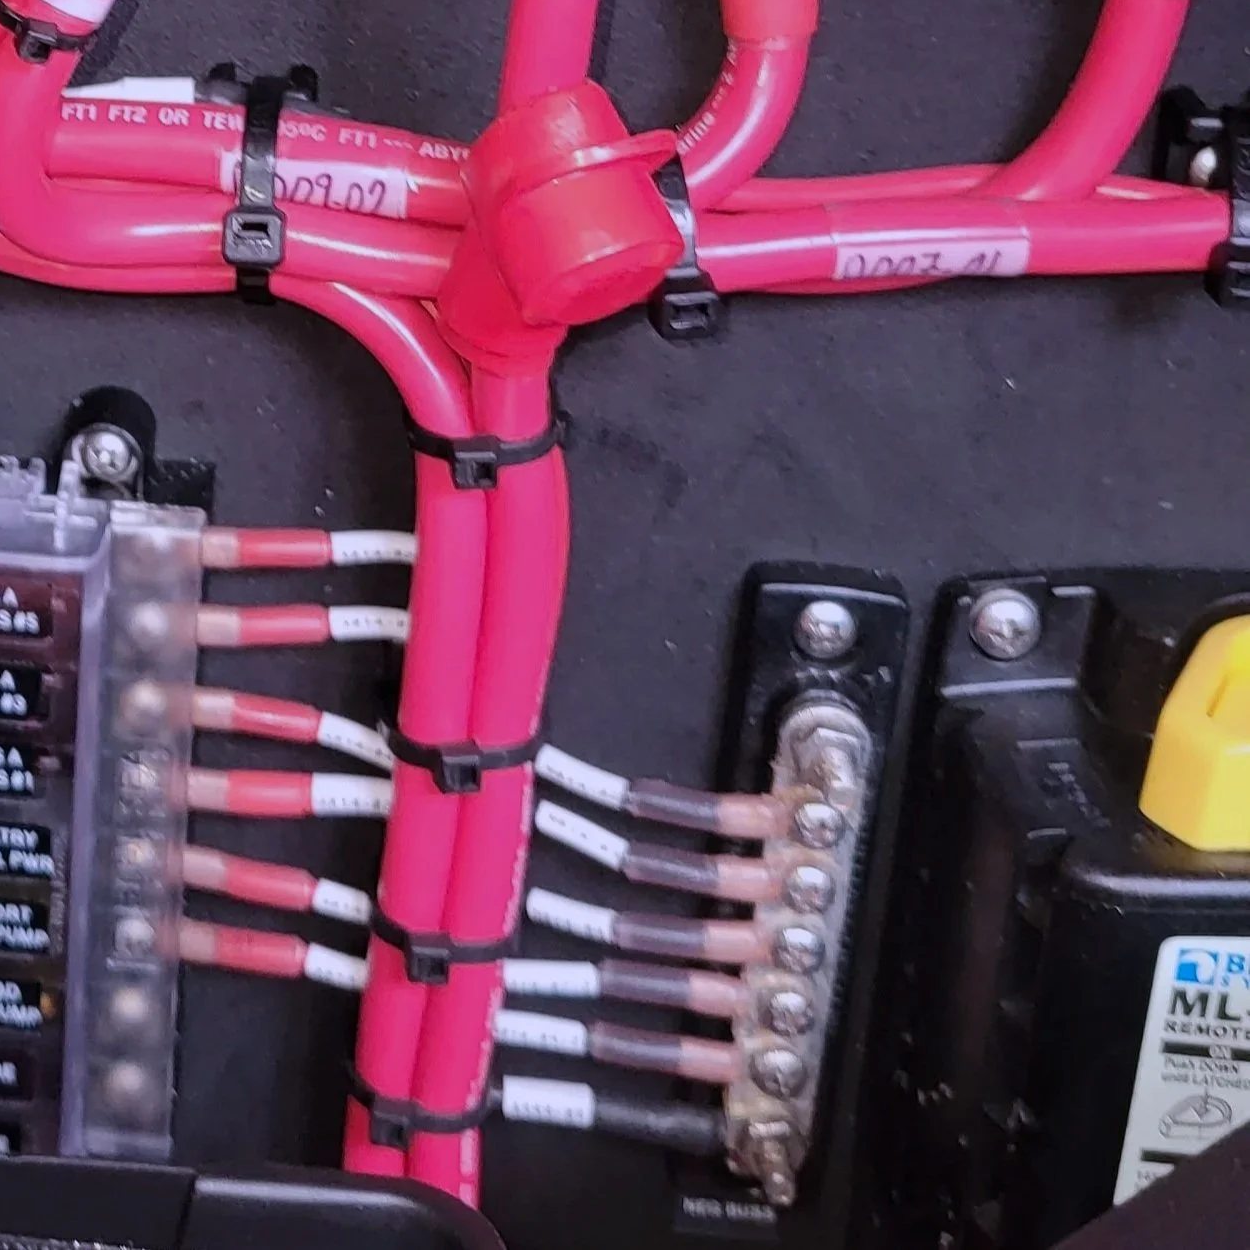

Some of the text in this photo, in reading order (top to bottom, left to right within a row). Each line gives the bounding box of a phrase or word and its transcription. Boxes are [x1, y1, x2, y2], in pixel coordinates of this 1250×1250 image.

[61, 103, 97, 123] FT1
[107, 105, 147, 125] FT2
[159, 108, 189, 128] OR
[338, 127, 377, 149] FT1
[2, 586, 18, 608] A
[0, 669, 16, 691] A
[7, 746, 23, 769] A
